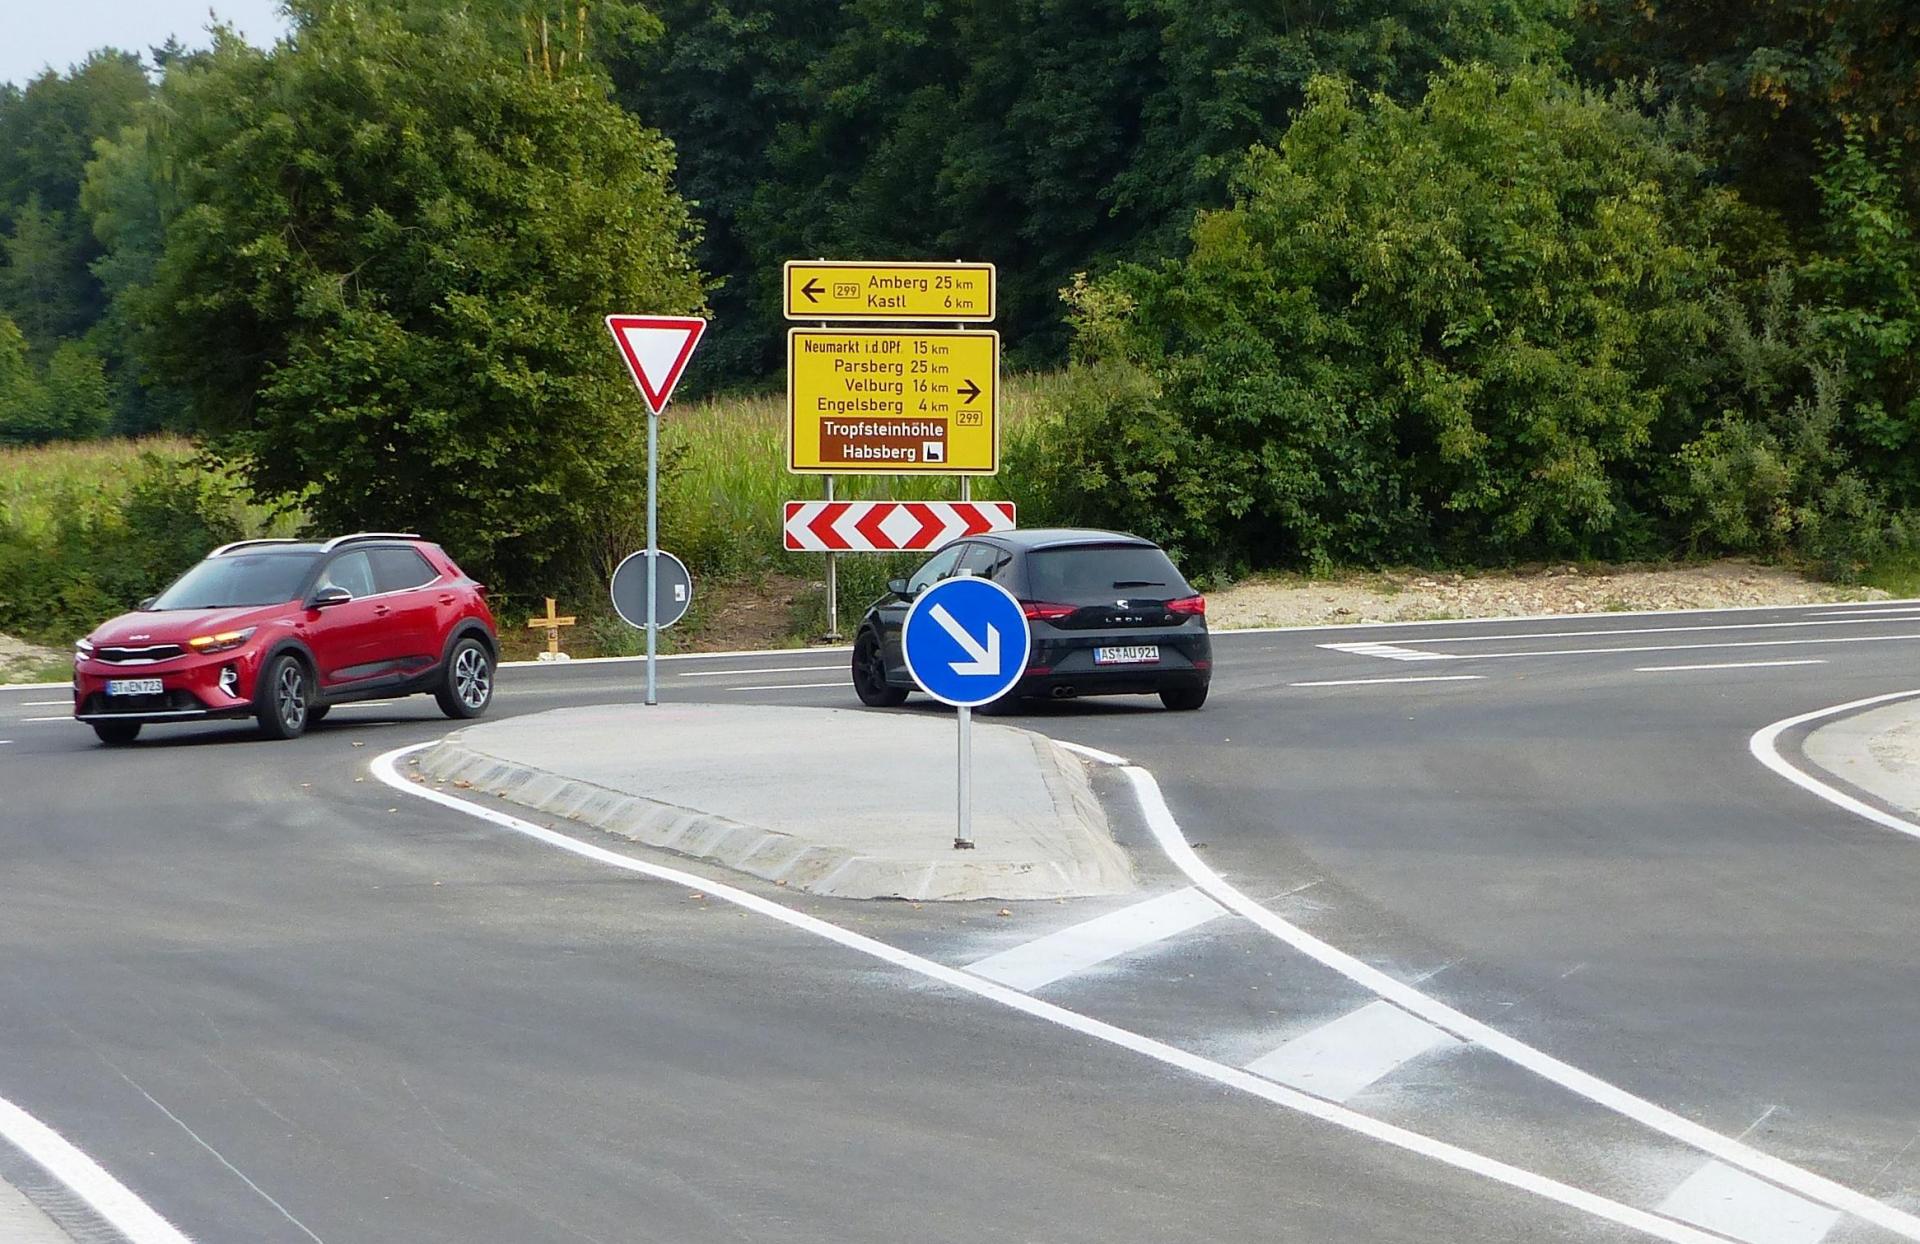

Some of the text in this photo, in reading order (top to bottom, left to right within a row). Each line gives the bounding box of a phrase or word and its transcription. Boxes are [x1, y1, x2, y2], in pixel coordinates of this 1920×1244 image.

[836, 286, 857, 297] 299
[868, 275, 973, 292] Amberg 25 km
[867, 295, 973, 309] Kastl 6 km
[804, 339, 860, 354] Neumarkt
[913, 341, 928, 355] 15
[931, 344, 949, 355] km
[834, 358, 949, 376] Parsberg 25 km
[845, 378, 949, 395] Velburg 16 km
[817, 397, 949, 414] Engelsberg 4 km
[959, 413, 979, 424] 299
[823, 421, 944, 438] Tropfsteinhöhle
[843, 444, 916, 462] Habsberg
